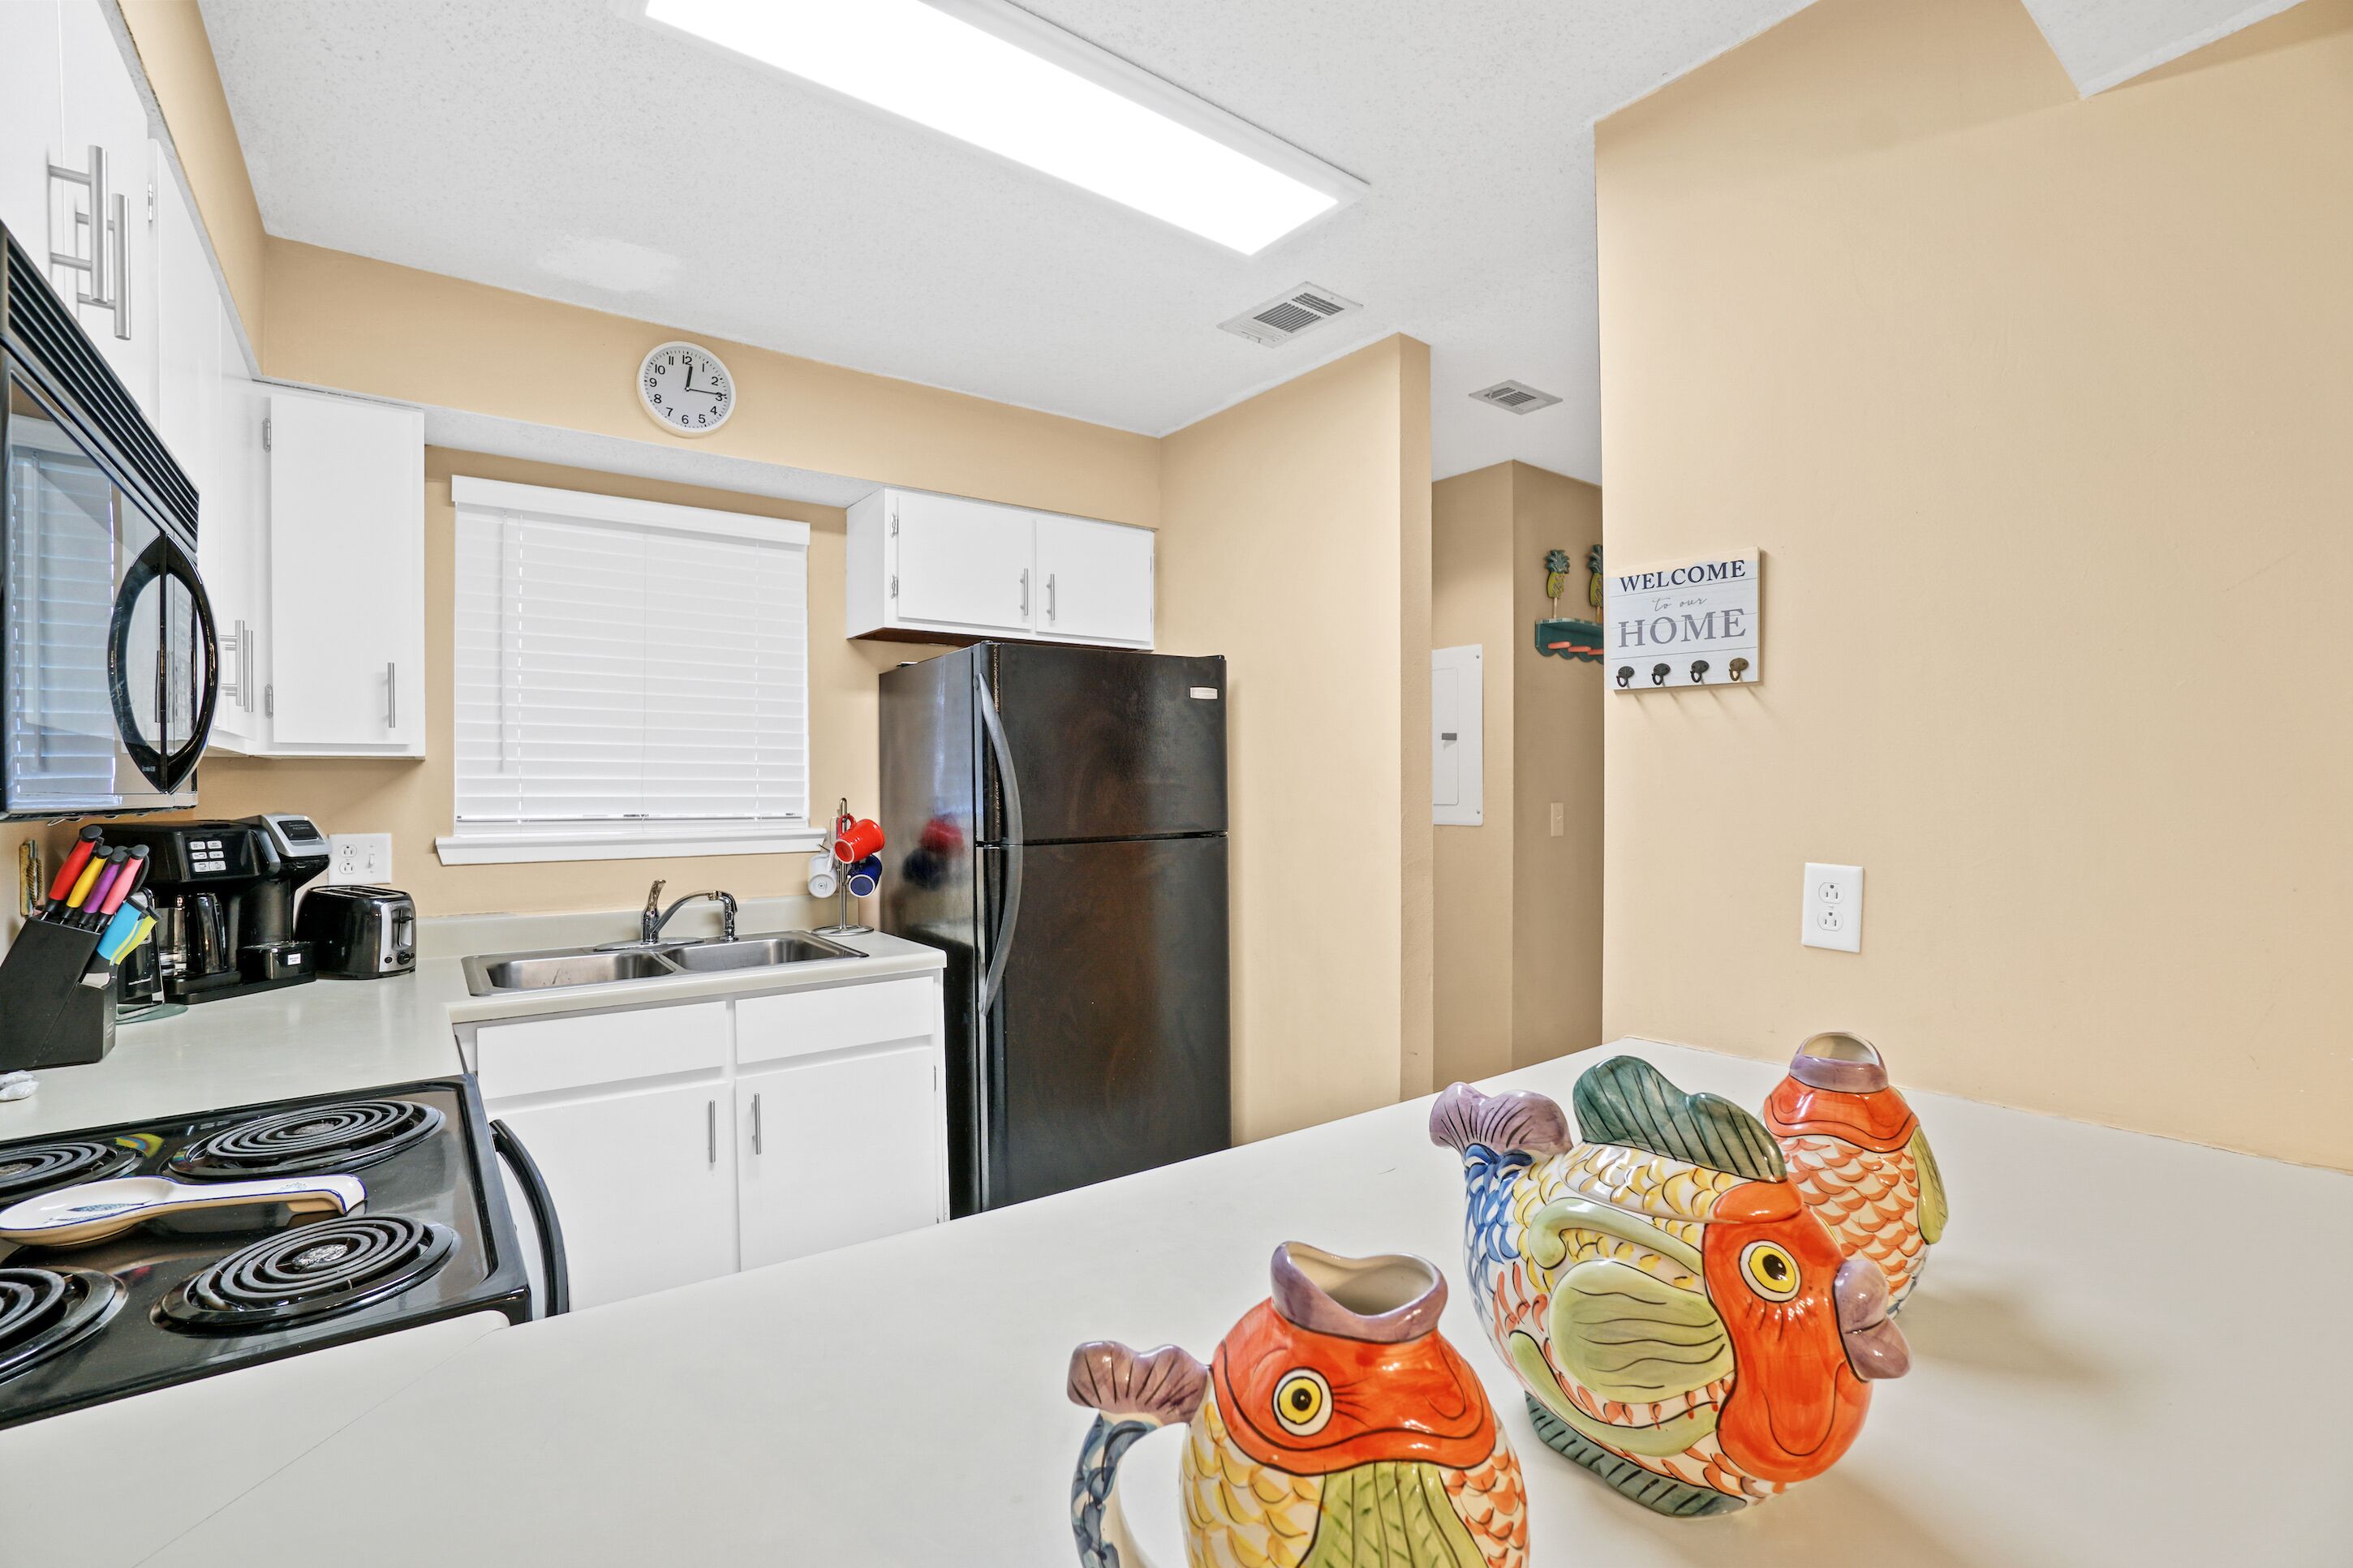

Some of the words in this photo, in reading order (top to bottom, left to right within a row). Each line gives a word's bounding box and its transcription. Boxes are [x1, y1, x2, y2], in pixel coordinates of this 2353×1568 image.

[669, 356, 674, 365] 11
[682, 354, 692, 365] 12
[655, 364, 665, 375] 10
[649, 378, 657, 388] 9
[711, 376, 719, 386] 2
[653, 393, 662, 404] 8
[666, 407, 673, 417] 7
[710, 406, 718, 415] 4
[682, 415, 690, 424] 6
[698, 415, 706, 423] 5
[1620, 560, 1746, 592] WELCOME
[1651, 597, 1671, 612] to
[1679, 598, 1708, 608] our
[1618, 608, 1747, 648] HOME
